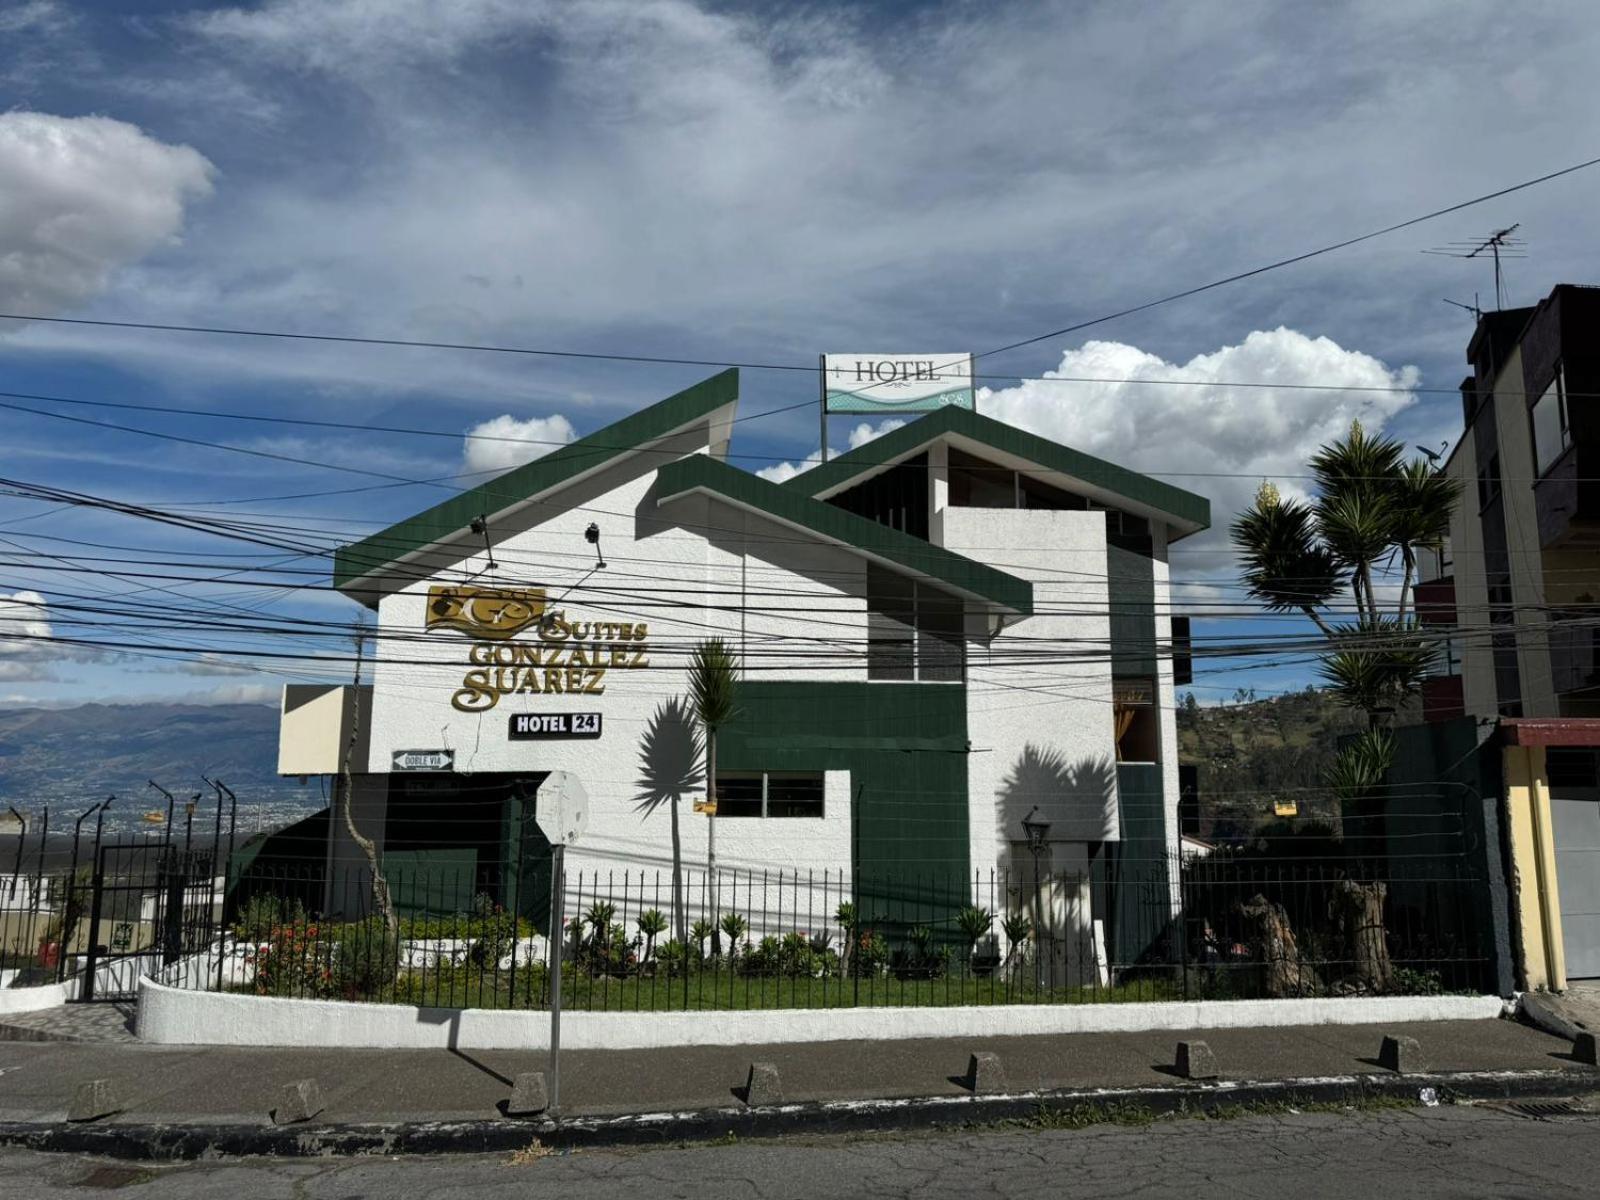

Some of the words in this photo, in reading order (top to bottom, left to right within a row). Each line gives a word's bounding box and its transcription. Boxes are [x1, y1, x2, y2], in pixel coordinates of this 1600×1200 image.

[855, 361, 941, 382] HOTEL
[469, 642, 650, 668] GONZALEZ
[451, 667, 606, 712] SUAREZ
[517, 716, 567, 732] HOTEL
[576, 715, 595, 729] 24
[405, 756, 427, 765] DOBLE
[429, 756, 441, 765] VIA
